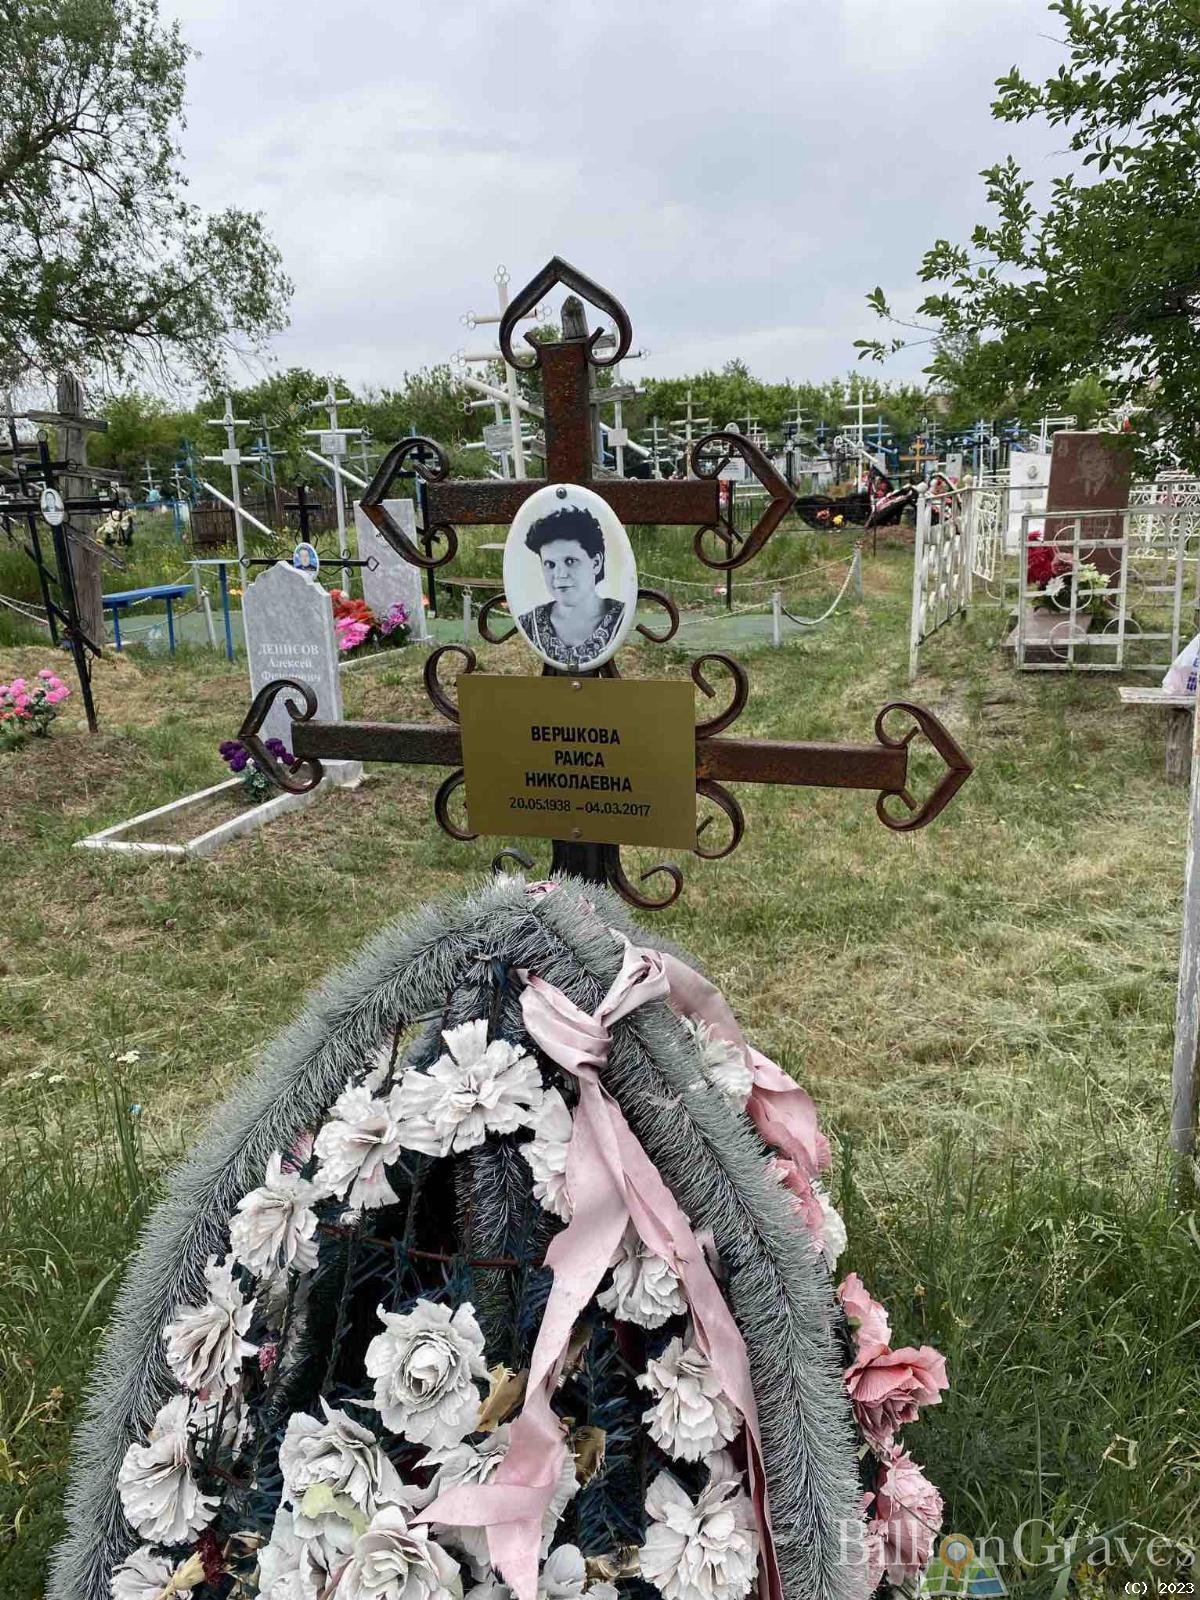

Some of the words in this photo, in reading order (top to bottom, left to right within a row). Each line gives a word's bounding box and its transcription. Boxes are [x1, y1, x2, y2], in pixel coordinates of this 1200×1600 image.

[258, 643, 320, 656] ДЕНИСОВ
[268, 657, 312, 669] Алексей
[531, 725, 621, 745] ВЕРШКОВА
[554, 750, 605, 768] РАИСА
[525, 772, 633, 792] НИКОЛАЕВНА
[509, 797, 571, 812] 20.05.1938
